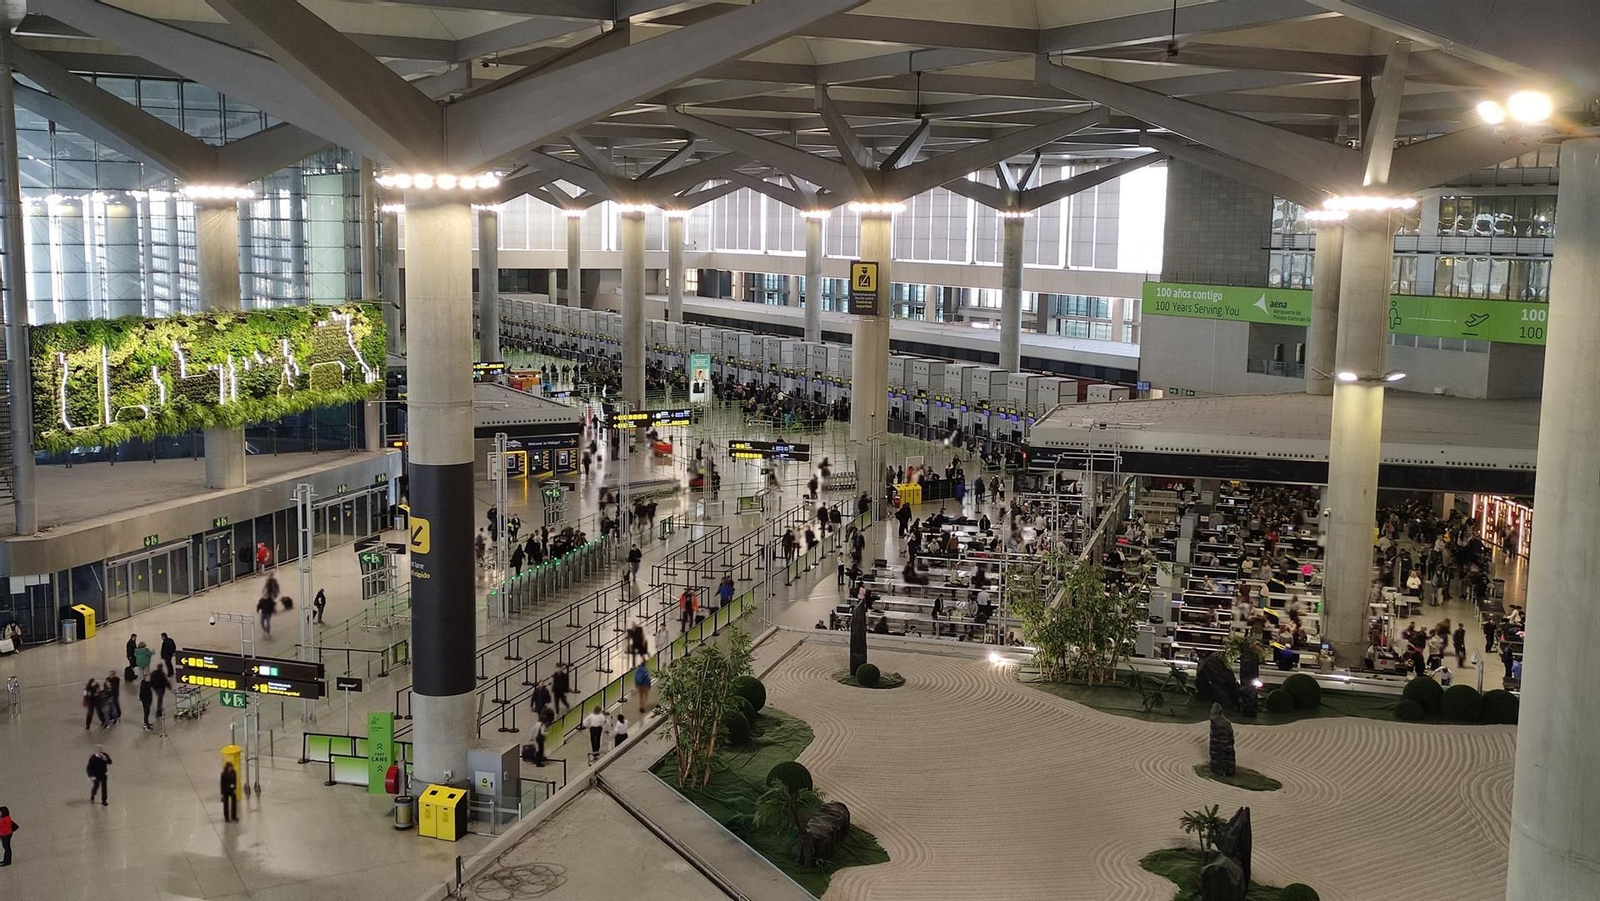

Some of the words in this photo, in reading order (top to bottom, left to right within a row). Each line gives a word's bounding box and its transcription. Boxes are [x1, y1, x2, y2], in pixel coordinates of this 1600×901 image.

[1156, 287, 1172, 298] 100
[1173, 289, 1192, 299] años
[1193, 290, 1223, 303] contigo
[1155, 301, 1170, 311] 100
[1172, 302, 1192, 313] Years
[1194, 303, 1223, 317] Serving
[1225, 305, 1240, 316] You
[1269, 300, 1288, 309] aena
[1521, 308, 1546, 322] 100
[1519, 326, 1543, 340] 100
[542, 450, 550, 469] ATM
